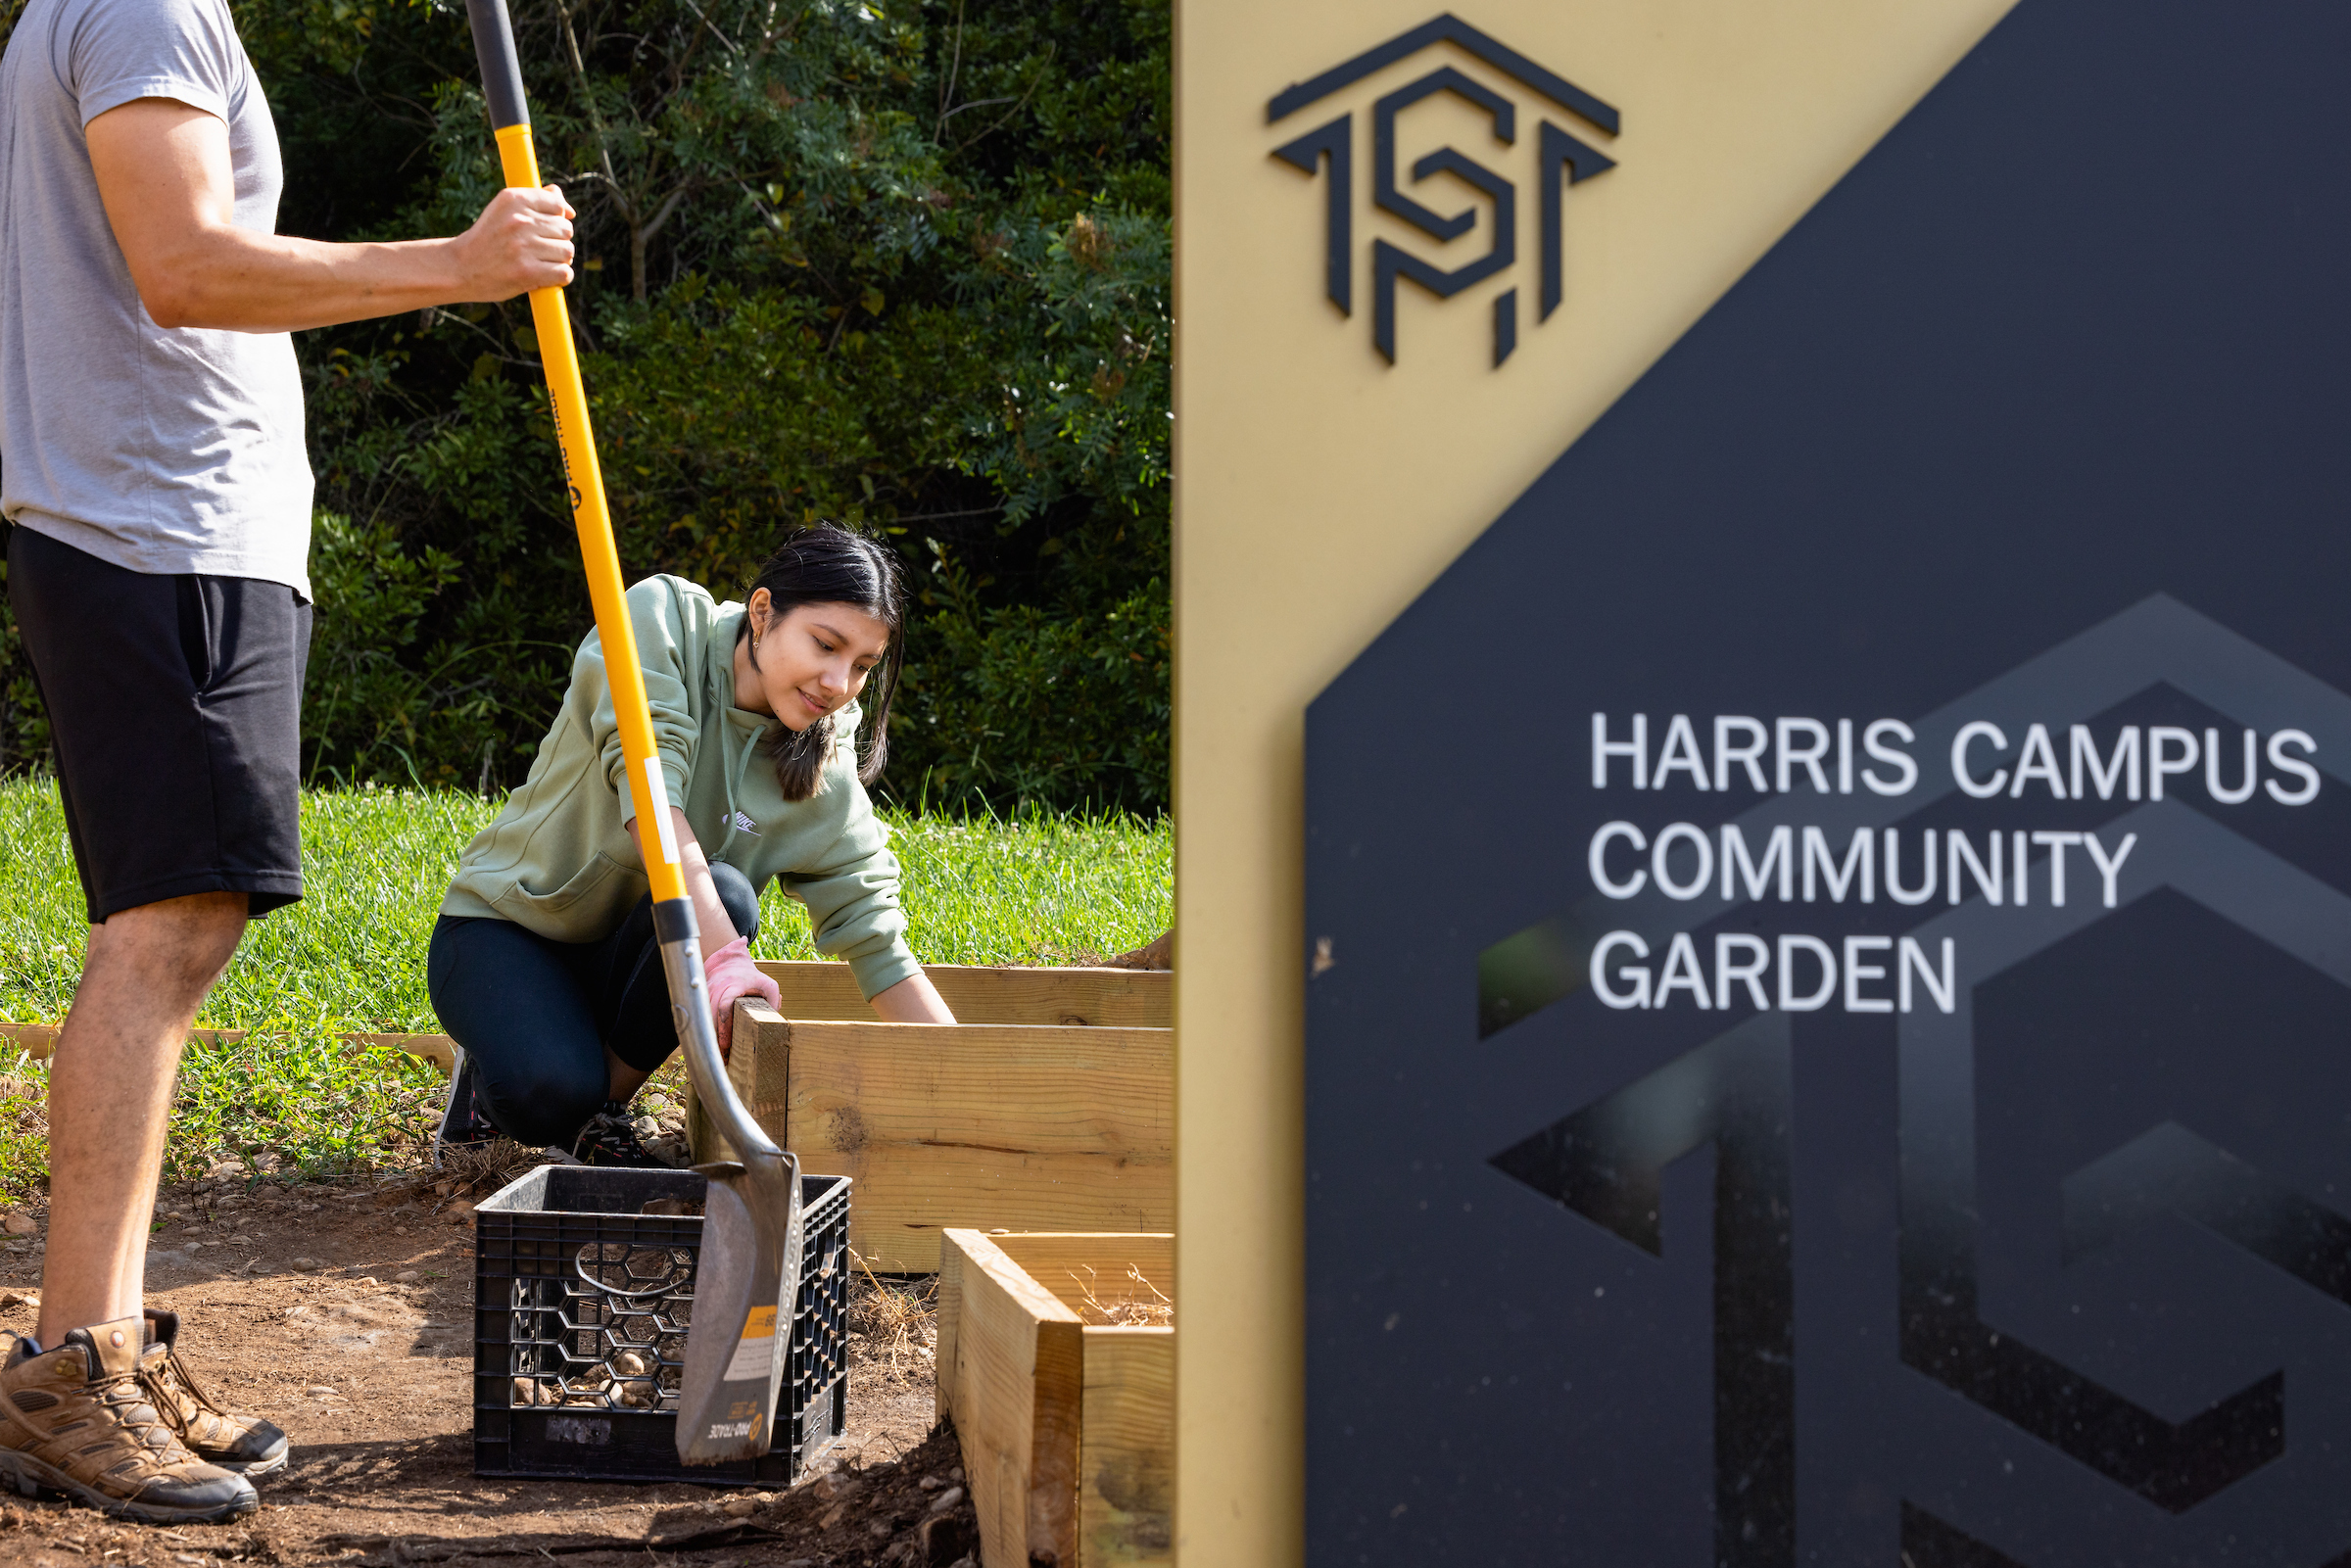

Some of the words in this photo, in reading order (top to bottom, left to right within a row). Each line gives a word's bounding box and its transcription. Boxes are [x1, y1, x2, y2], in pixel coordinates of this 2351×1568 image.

[1590, 711, 1920, 797] HARRIS
[1949, 719, 2323, 807] CAMPUS
[1587, 820, 2138, 909] COMMUNITY
[1588, 928, 1956, 1014] GARDEN
[708, 1421, 752, 1440] PRO-TRADE
